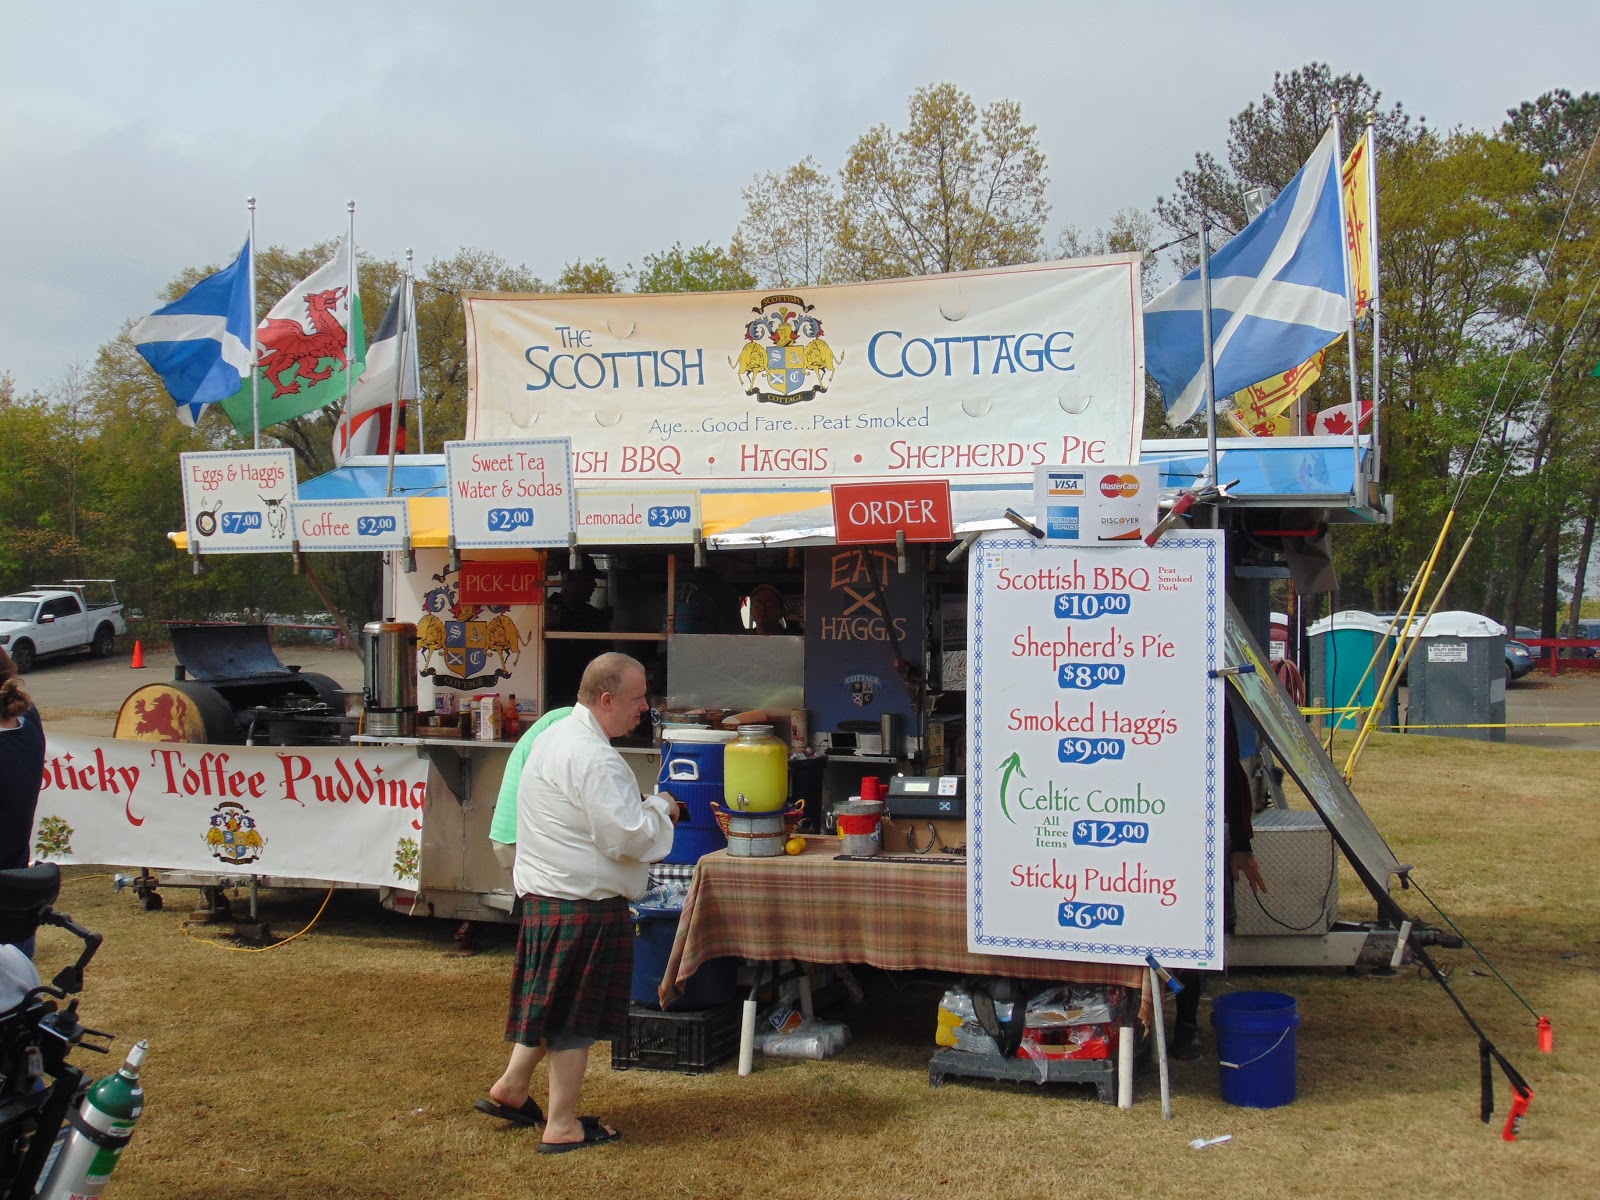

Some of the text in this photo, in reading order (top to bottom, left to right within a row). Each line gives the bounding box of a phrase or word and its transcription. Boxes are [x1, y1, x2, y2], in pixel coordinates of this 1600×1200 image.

[763, 295, 801, 305] SCOTTISH
[555, 326, 592, 348] THE
[867, 330, 1076, 378] COTTAGE
[525, 345, 704, 391] SCOTTISH
[767, 393, 803, 404] COTTAGE
[856, 406, 929, 429] Smoked
[471, 452, 545, 472] Sweet Tea
[572, 435, 1106, 475] ISH BBQ HAGGIS SHEPHERD'S PIE
[192, 461, 284, 491] Eggs & Haggis
[457, 472, 563, 498] Water & Sodas
[1054, 480, 1077, 489] VISA
[1100, 482, 1138, 490] MasterCard
[223, 514, 259, 533] $7.00
[490, 510, 529, 529] $2.00
[577, 503, 687, 526] Lemonade $3.00
[849, 499, 937, 526] ORDER
[302, 513, 392, 537] Coffee $2.00
[830, 549, 897, 590] EAT
[997, 559, 1085, 590] Scottish
[1093, 567, 1151, 592] BBQ
[1158, 566, 1177, 574] Peat
[1158, 575, 1193, 583] Smoked
[466, 574, 535, 592] PICK-UP
[1058, 594, 1126, 616] $10.00
[821, 617, 907, 641] HAGGS
[1012, 626, 1175, 672] Shepherd's Pie
[444, 677, 484, 688] COTTAGE
[1063, 665, 1120, 687] $8.00
[1008, 701, 1178, 745] Smoked Haggis
[1063, 739, 1120, 762] $9.00
[151, 749, 267, 798] Toffee
[1018, 780, 1166, 815] Celtic Combo
[1034, 826, 1069, 838] Three
[1042, 816, 1059, 826] All
[1076, 821, 1145, 844] $12.00
[1035, 838, 1068, 848] Items
[1010, 858, 1177, 906] Sticky Pudding
[1063, 904, 1119, 927] $6.00
